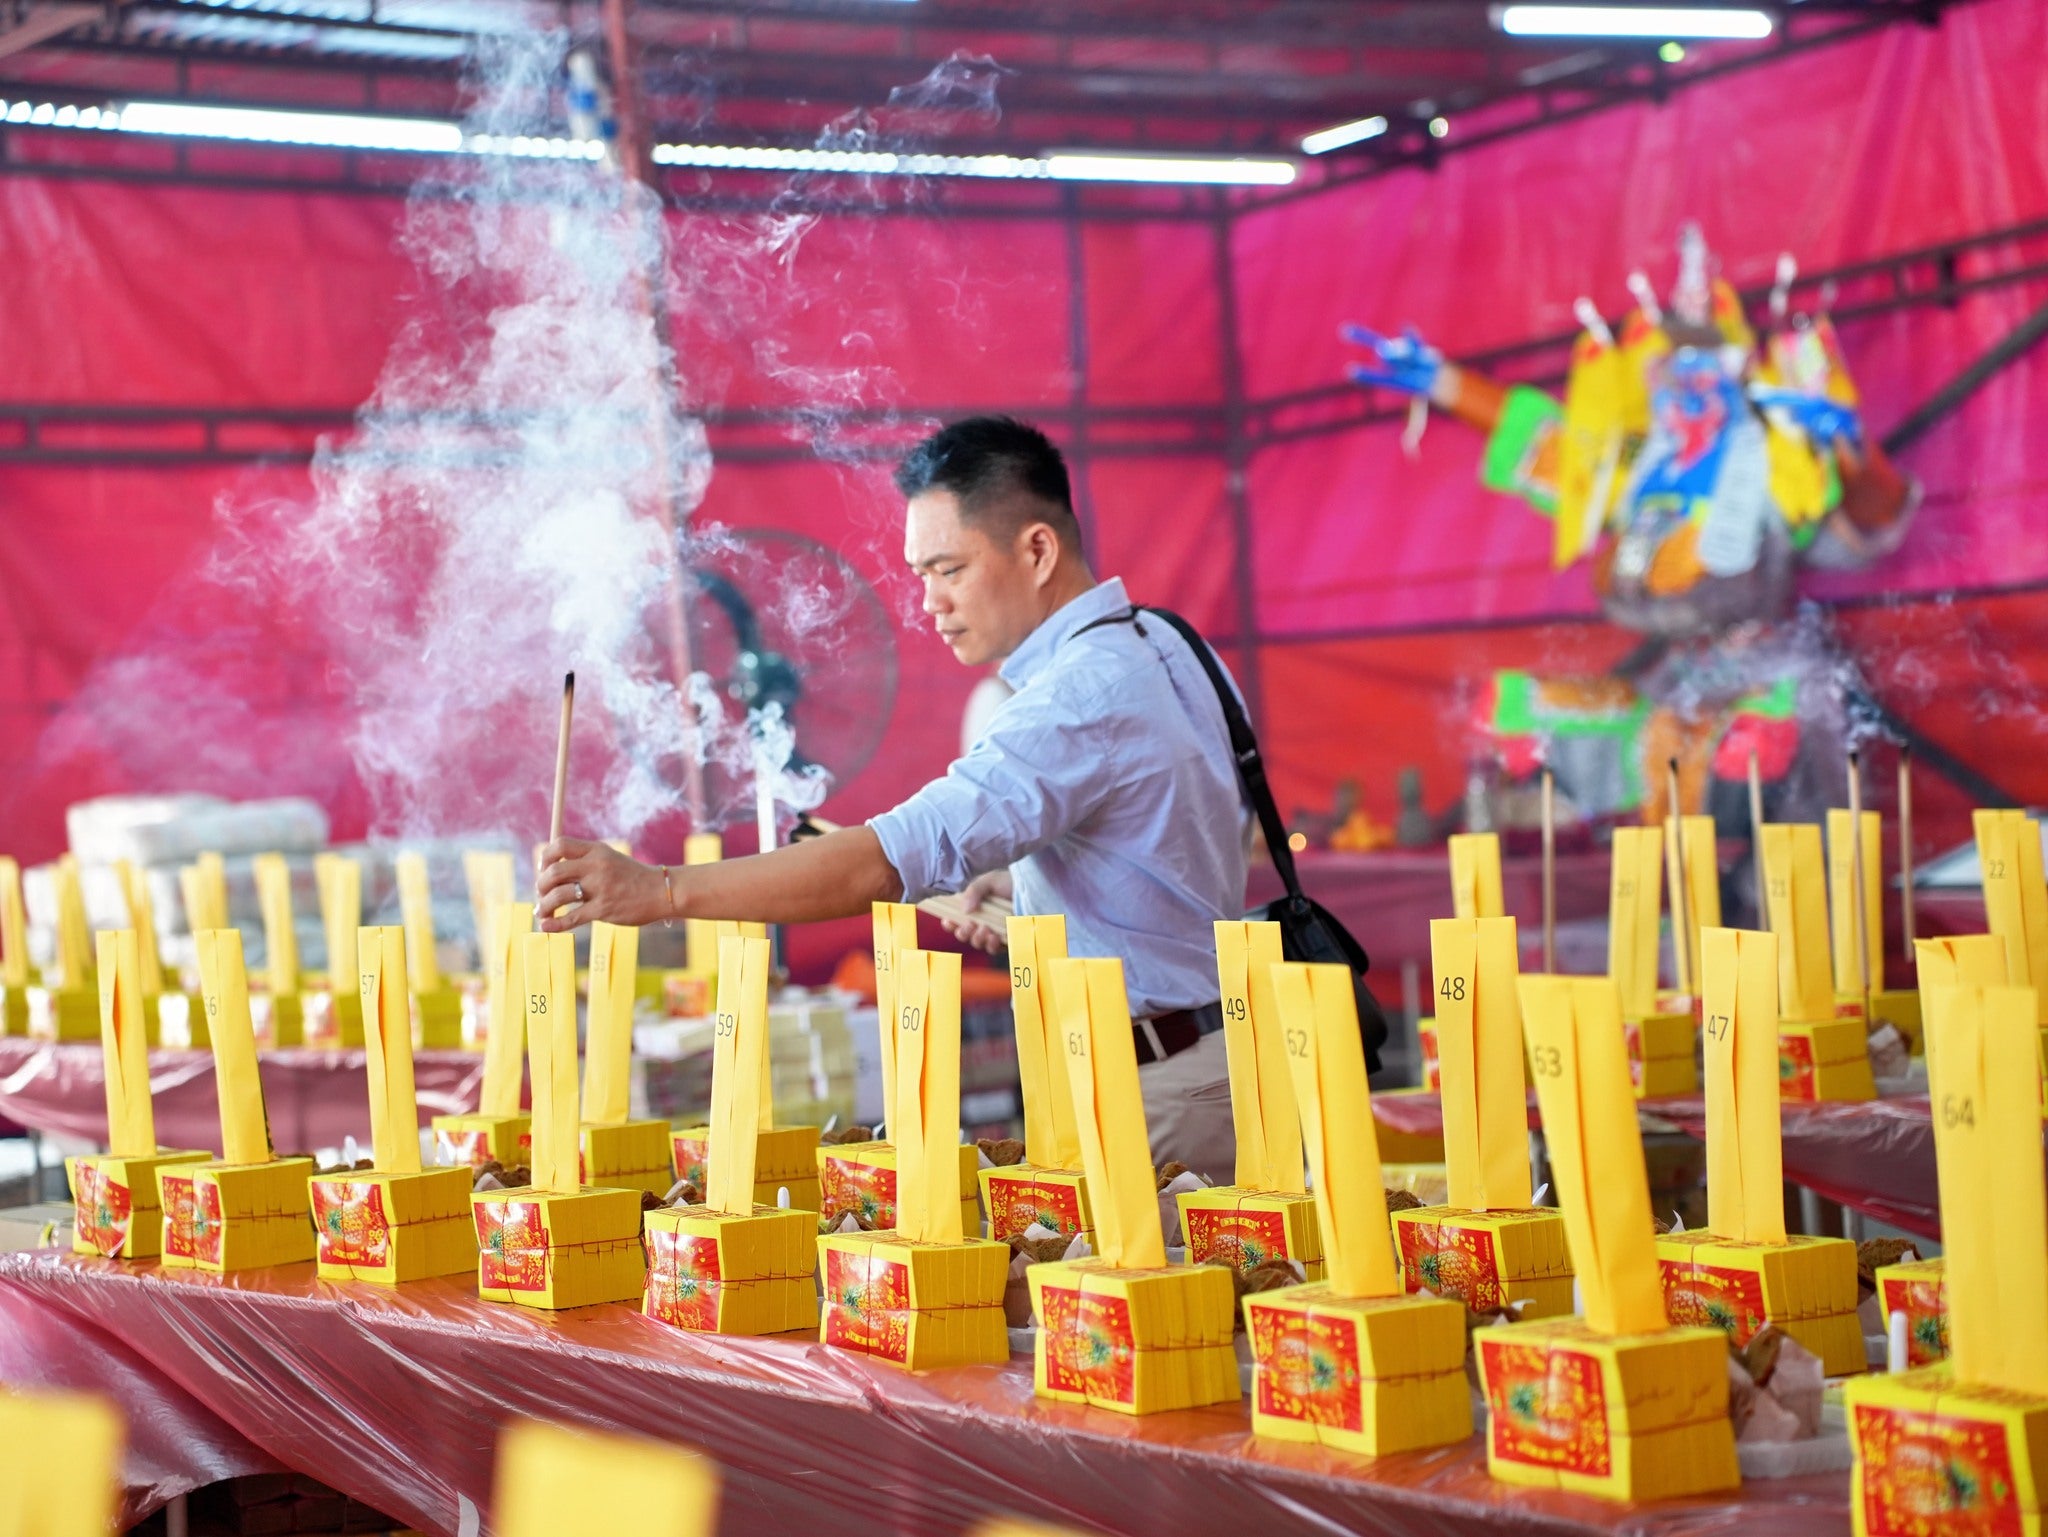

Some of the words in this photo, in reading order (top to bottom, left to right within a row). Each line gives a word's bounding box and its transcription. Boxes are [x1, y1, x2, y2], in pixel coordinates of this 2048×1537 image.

[877, 950, 890, 971] 51
[362, 975, 375, 995] 57
[1013, 967, 1032, 989] 50
[1440, 976, 1465, 1001] 48
[530, 994, 547, 1015] 58
[1226, 997, 1246, 1021] 49
[717, 1013, 734, 1037] 59
[902, 1006, 921, 1031] 60
[1707, 1014, 1729, 1041] 47
[1068, 1032, 1086, 1057] 61
[1286, 1028, 1309, 1058] 62
[1534, 1045, 1563, 1078] 63
[1940, 1095, 1975, 1130] 64
